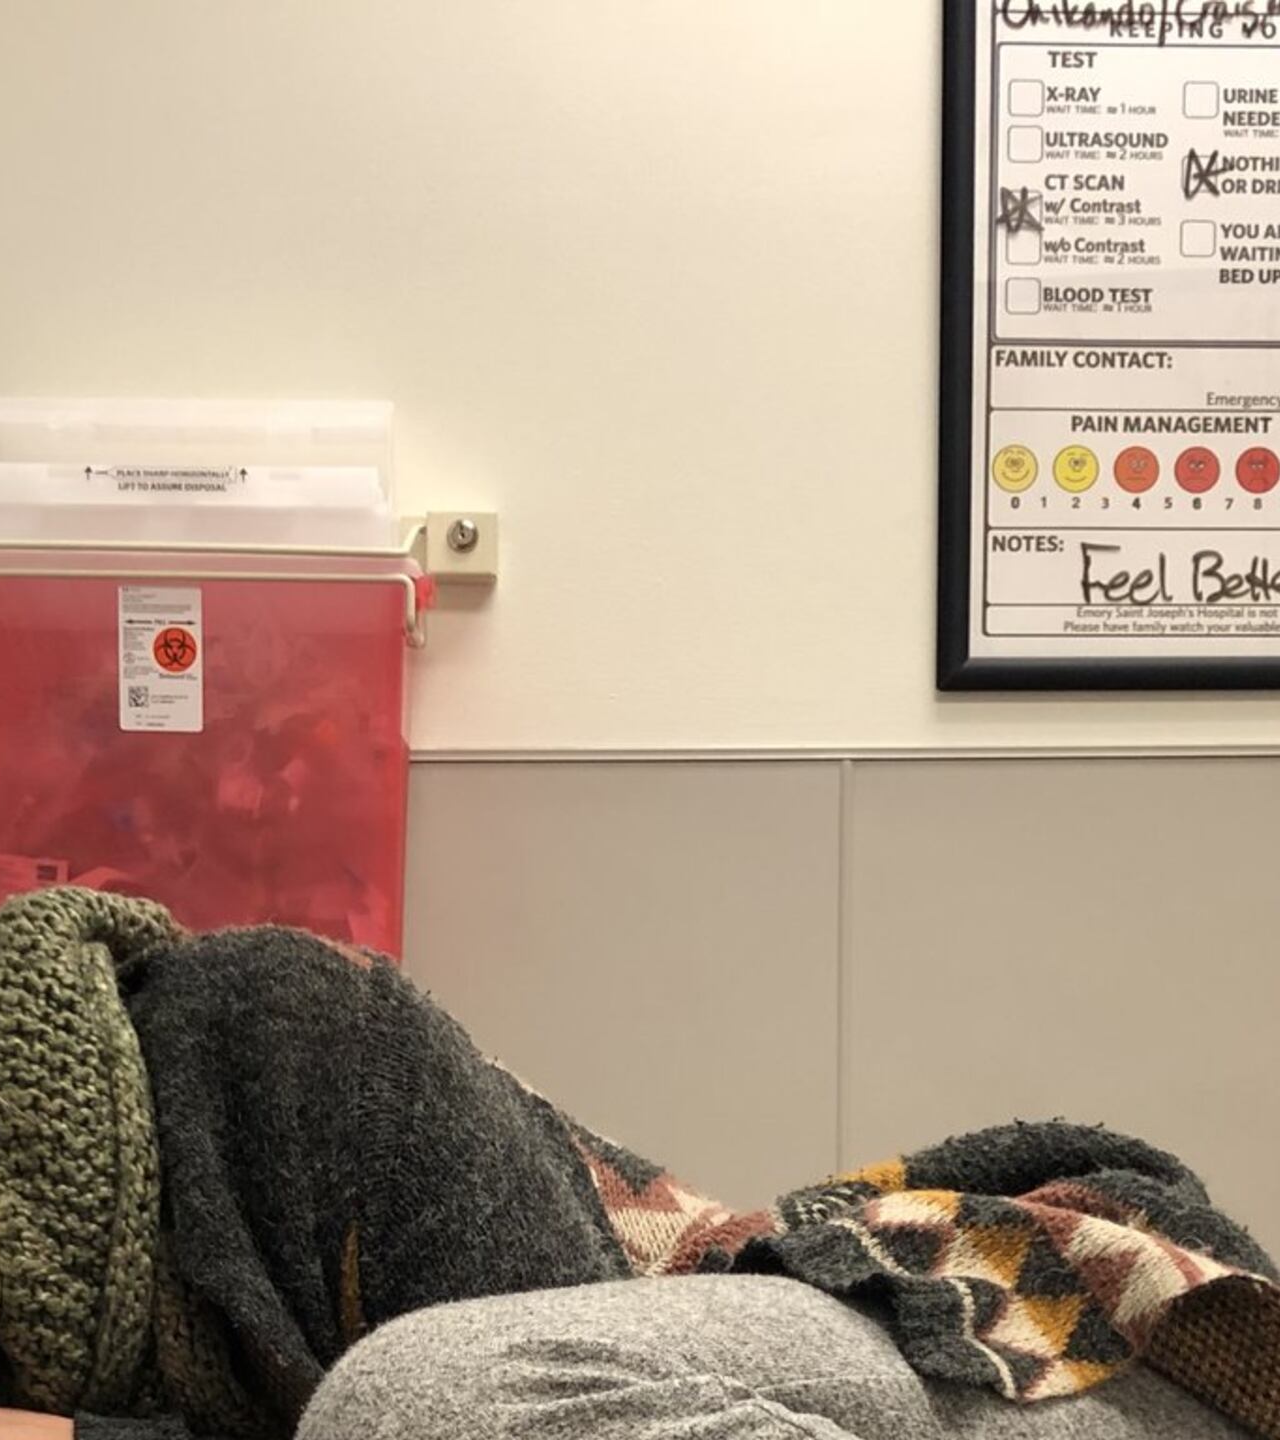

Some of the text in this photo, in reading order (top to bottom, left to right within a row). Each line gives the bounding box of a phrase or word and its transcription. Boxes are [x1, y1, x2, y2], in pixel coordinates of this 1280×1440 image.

[1109, 22, 1223, 39] KEEPING
[1047, 51, 1098, 68] TEST
[1046, 86, 1101, 102] X-RAY
[1223, 88, 1278, 104] URINE
[1046, 105, 1070, 114] WAIT
[1120, 103, 1126, 114] 1
[1128, 106, 1156, 115] HOUR
[1045, 132, 1169, 148] ULTRASOUND
[1223, 129, 1248, 138] WAIT
[1045, 150, 1070, 160] WAIT
[1119, 149, 1128, 160] 2
[1130, 150, 1163, 160] HOURS
[1044, 174, 1125, 191] CT SCAN
[1221, 178, 1247, 194] OR
[1044, 198, 1141, 215] w/ Contrast
[1044, 216, 1068, 225] WAIT
[1119, 214, 1126, 225] 3
[1128, 216, 1162, 226] HOURS
[1220, 223, 1260, 239] YOU
[1044, 237, 1146, 254] w/o Contrast
[1044, 255, 1068, 264] WAIT
[1117, 252, 1125, 265] 2
[1127, 255, 1161, 265] HOURS
[1219, 269, 1254, 284] BED
[1043, 287, 1153, 303] BLOOD TEST
[1043, 304, 1067, 313] WAIT
[1116, 302, 1121, 313] 1
[1124, 304, 1153, 313] HOUR
[995, 350, 1173, 369] FAMILY CONTACT:
[1071, 415, 1272, 433] PAIN MANAGEMENT
[118, 483, 228, 492] LIFT TO ASSURE DISPOSAL
[1010, 497, 1020, 510] 0
[1041, 497, 1046, 510] 1
[1071, 497, 1080, 510] 2
[1101, 497, 1110, 510] 3
[1132, 497, 1141, 510] 4
[1164, 497, 1173, 510] 5
[1192, 497, 1201, 510] 6
[1224, 497, 1234, 510] 7
[1253, 497, 1263, 510] 8
[991, 535, 1065, 552] NOTES:
[1079, 542, 1173, 604] Feel
[1076, 607, 1112, 619] Emory
[1115, 607, 1144, 618] Saint
[1147, 607, 1195, 619] Joseph's
[1197, 607, 1244, 619] Hospital
[1247, 608, 1257, 618] is
[1259, 608, 1278, 618] not
[1063, 622, 1100, 633] Please
[1102, 622, 1130, 633] have
[1132, 622, 1166, 634] family
[1170, 622, 1204, 633] watch
[1207, 624, 1232, 634] your
